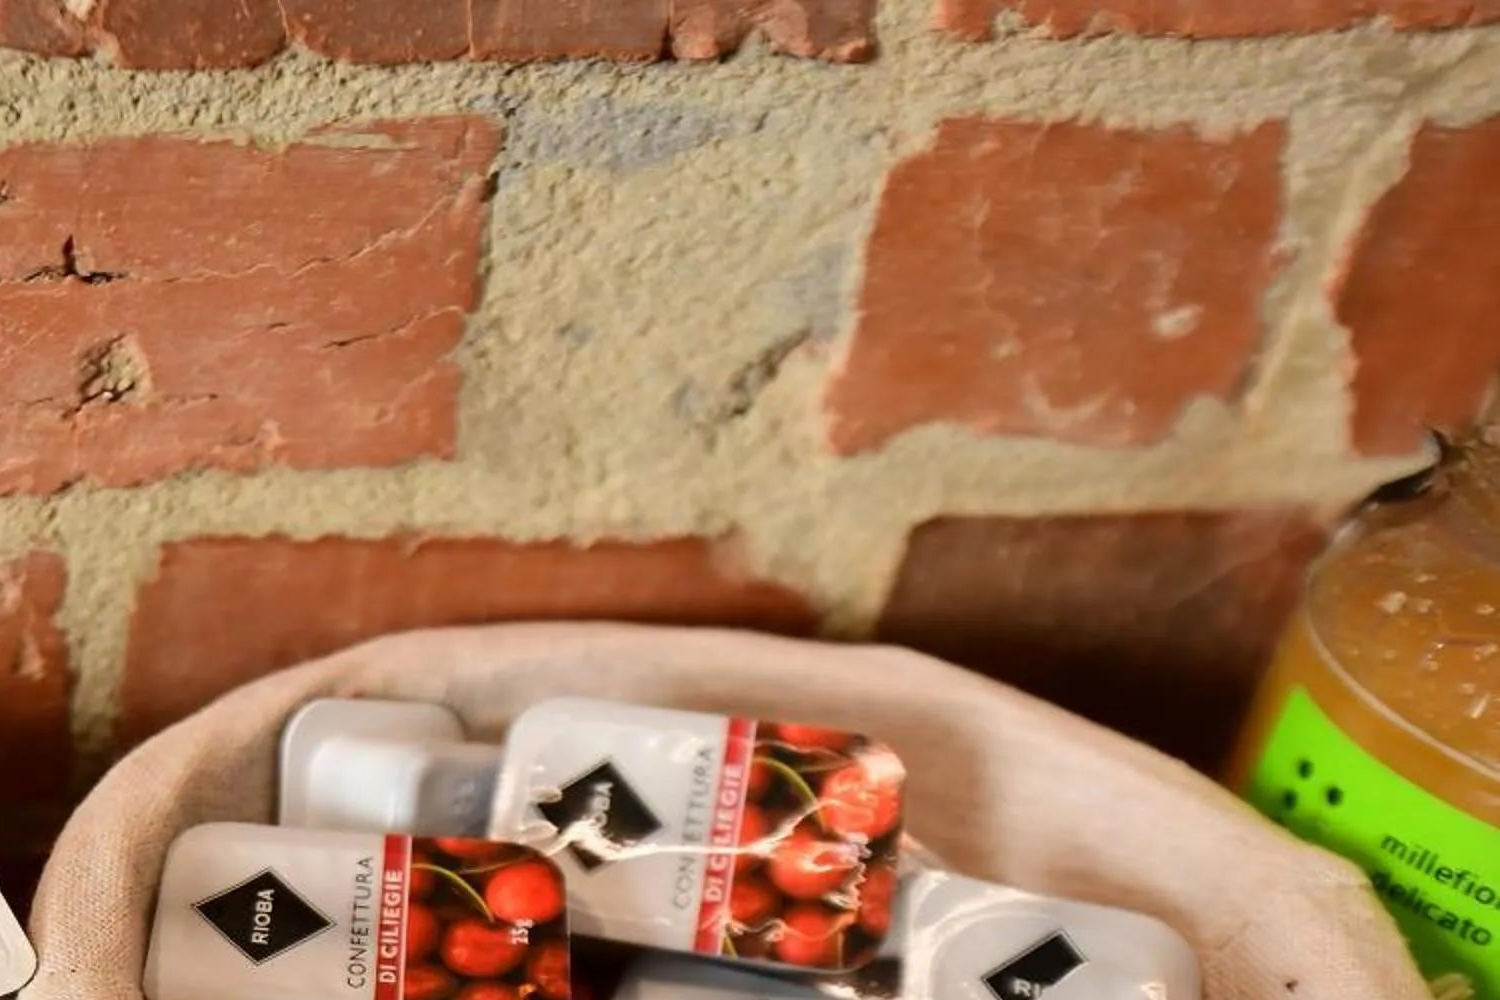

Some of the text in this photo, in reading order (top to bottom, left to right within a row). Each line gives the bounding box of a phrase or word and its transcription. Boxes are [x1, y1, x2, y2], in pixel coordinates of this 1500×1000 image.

[250, 887, 275, 944] RIOBA
[346, 856, 374, 988] CONFETTURA
[379, 869, 404, 985] DI CILIEGIE
